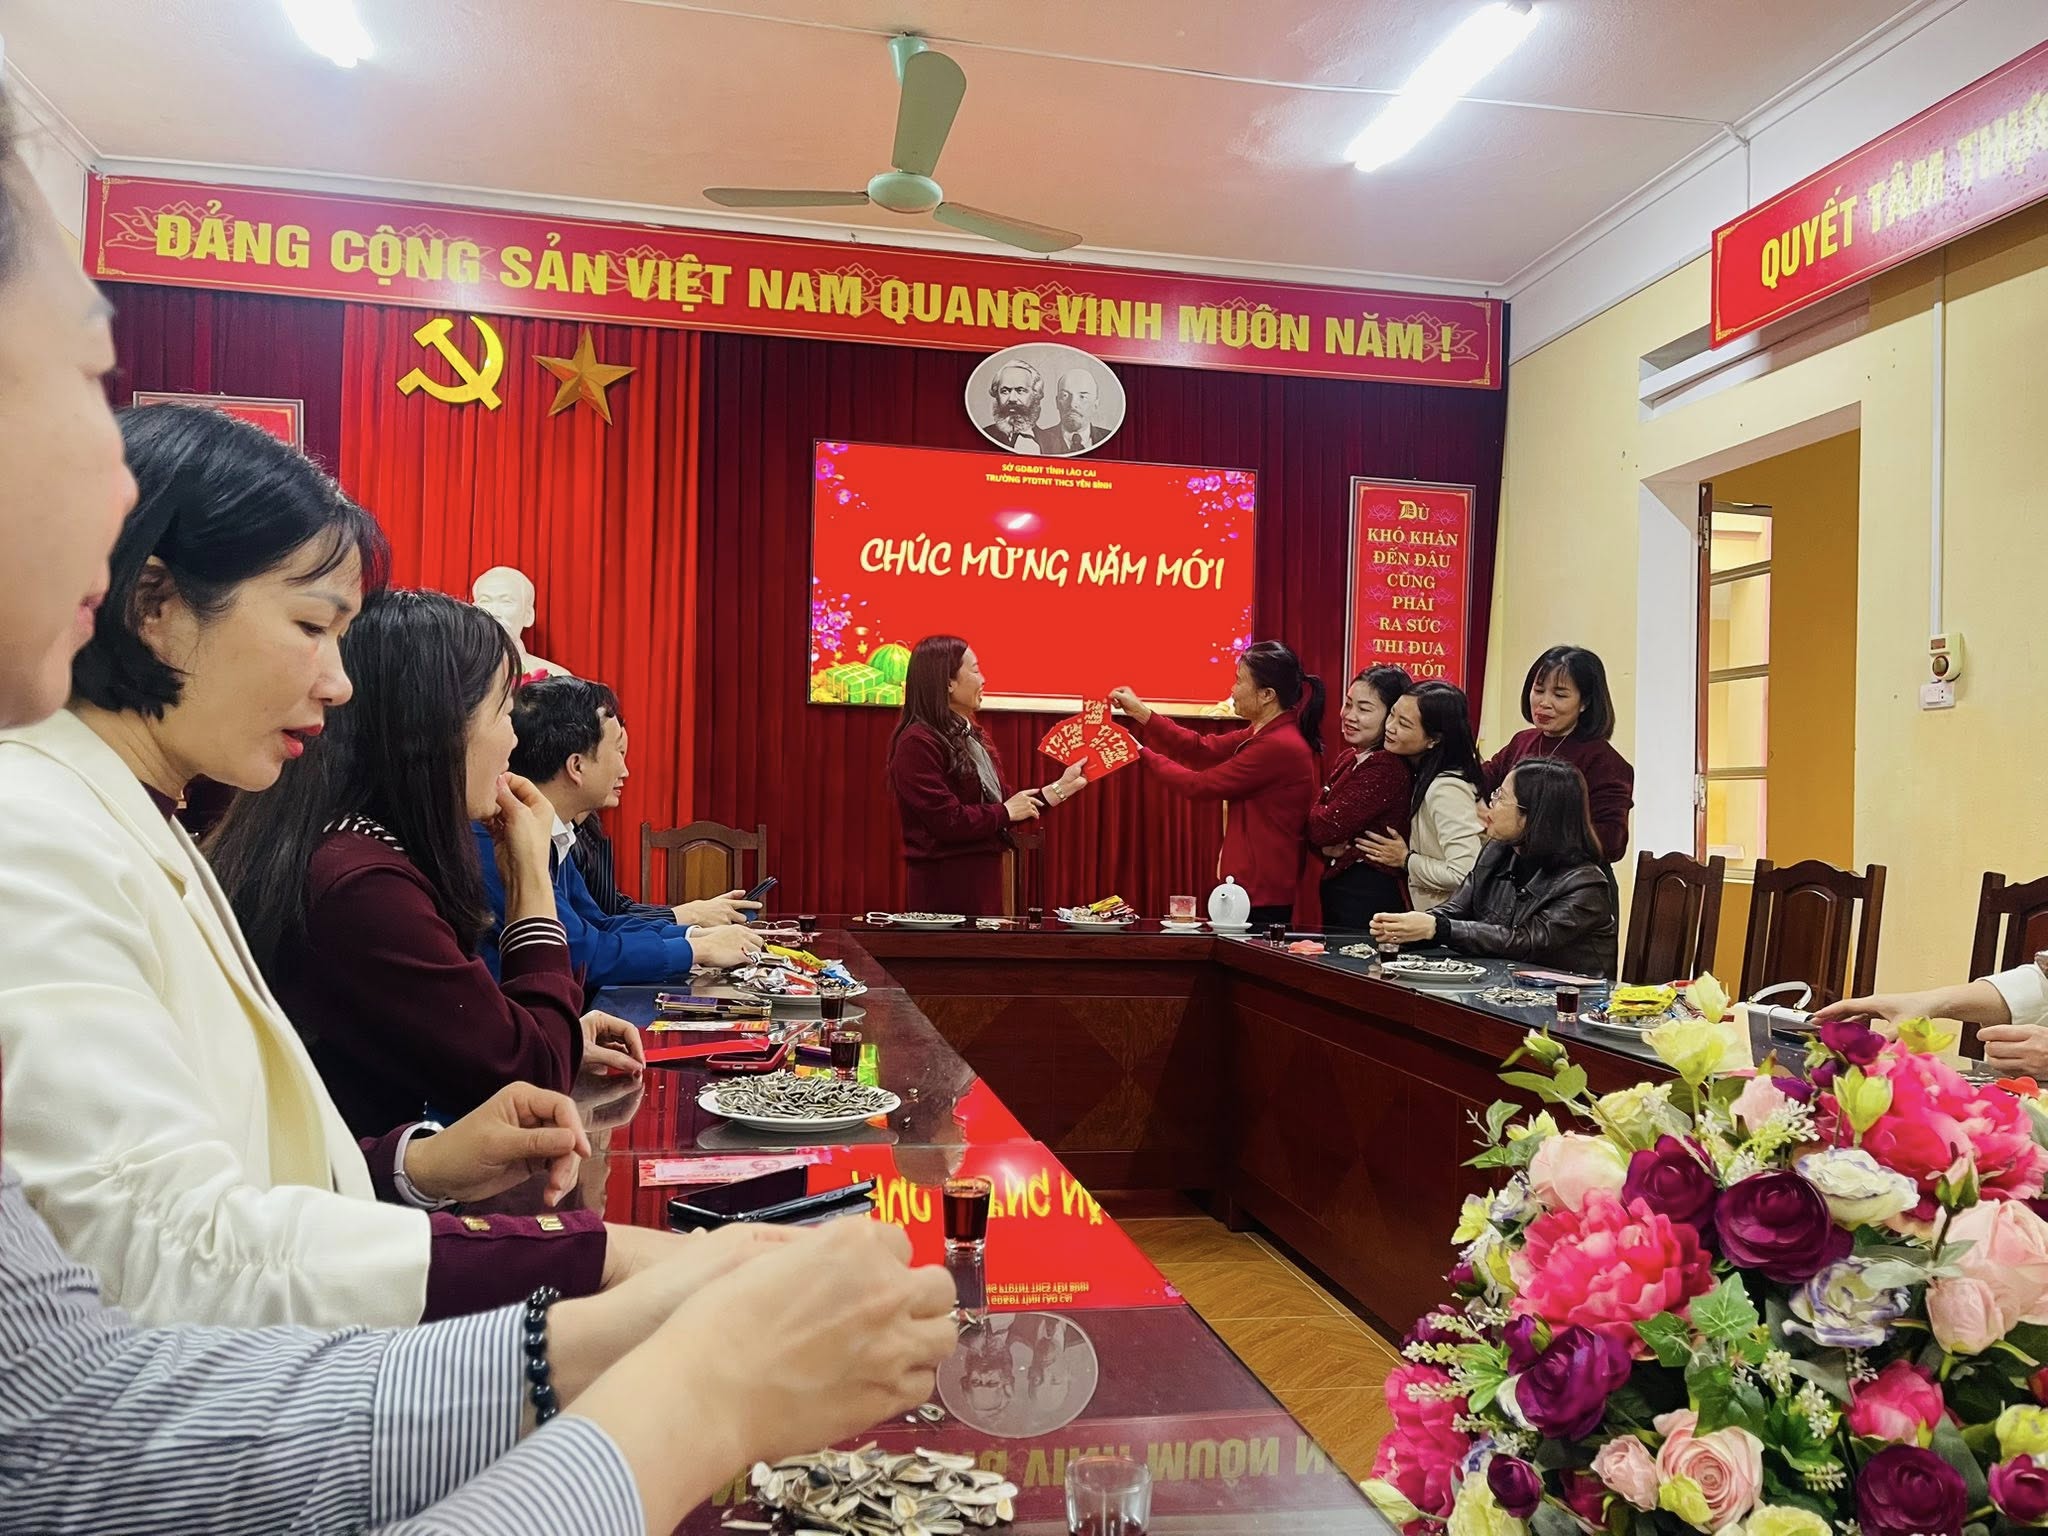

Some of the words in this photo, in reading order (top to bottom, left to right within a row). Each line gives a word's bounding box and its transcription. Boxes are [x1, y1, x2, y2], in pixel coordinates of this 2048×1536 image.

[1760, 184, 1858, 290] QUYẾT
[1866, 148, 1946, 234] TÂM
[154, 199, 310, 269] ĐẢNG
[330, 224, 481, 287] CỘNG
[499, 231, 608, 297] SẢN
[625, 252, 733, 313] VIỆT
[747, 267, 863, 318] NAM
[879, 279, 1041, 332] QUANG
[1055, 294, 1163, 341] VINH
[1178, 303, 1310, 353] MUÔN
[1324, 311, 1424, 361] NĂM
[1440, 325, 1452, 363] !
[1001, 462, 1014, 472] SỞ
[1066, 466, 1082, 477] LÀO
[1083, 469, 1097, 478] CAI
[985, 473, 1021, 484] TRƯỜNG
[1054, 478, 1075, 488] THCS
[1075, 479, 1091, 489] YÊN
[1092, 480, 1113, 490] BÌNH
[1397, 499, 1430, 521] DÙ
[1367, 526, 1406, 544] KHÓ
[1409, 528, 1459, 547] KHĂN
[859, 532, 952, 577] CHÚC
[960, 537, 1070, 588] MỪNG
[1077, 543, 1148, 587] NĂM
[1155, 548, 1226, 591] MỚI
[1372, 547, 1410, 566] ĐẾN
[1413, 550, 1451, 568] ĐÂU
[1386, 570, 1436, 590] CŨNG
[1391, 592, 1435, 612] PHẢI
[1378, 617, 1403, 632] RA
[1406, 616, 1442, 633] SỨC
[1372, 639, 1404, 654] THI
[1407, 640, 1446, 656] ĐUA
[1410, 658, 1446, 678] TỐT
